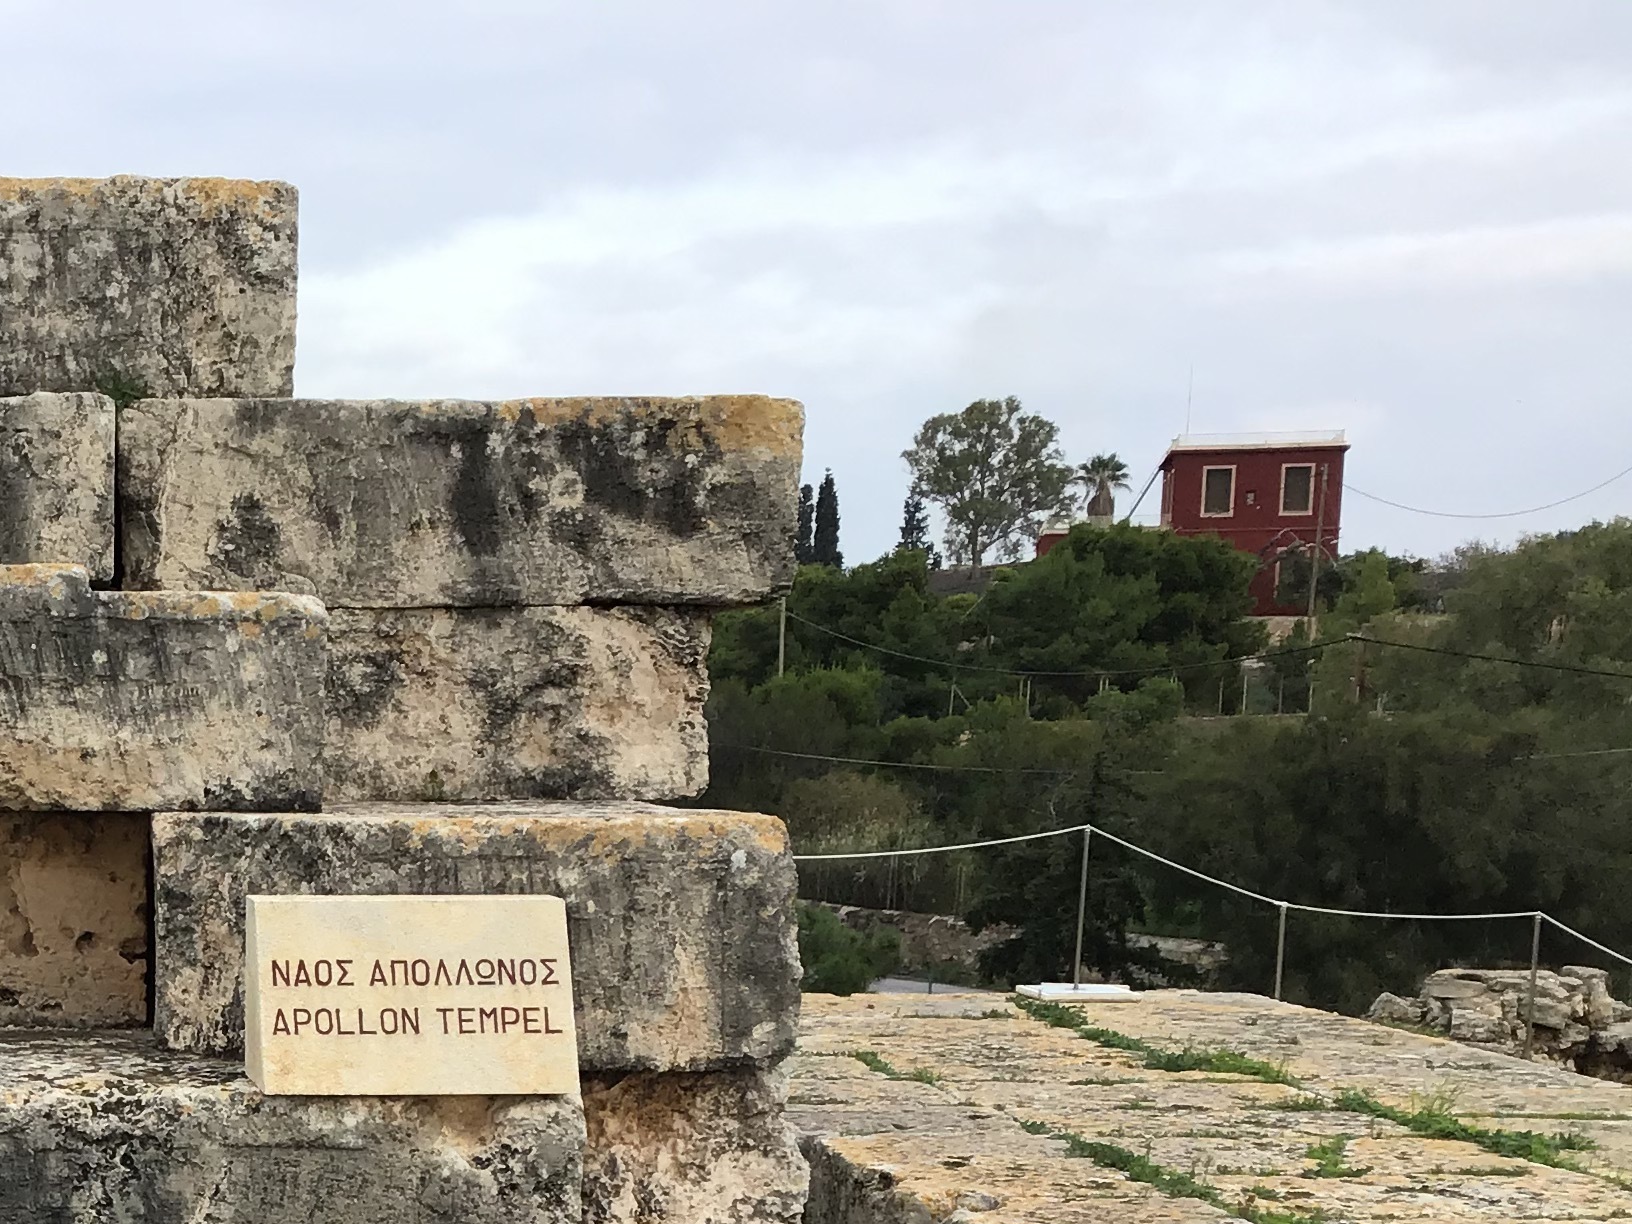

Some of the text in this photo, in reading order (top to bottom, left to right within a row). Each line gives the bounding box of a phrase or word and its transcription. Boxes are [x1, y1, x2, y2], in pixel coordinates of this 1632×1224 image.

[271, 958, 560, 987] ΝΑΟΣ ΑΠΟΛΛΩΝΟΣ
[272, 1006, 563, 1036] APOLLON TEMPEL
